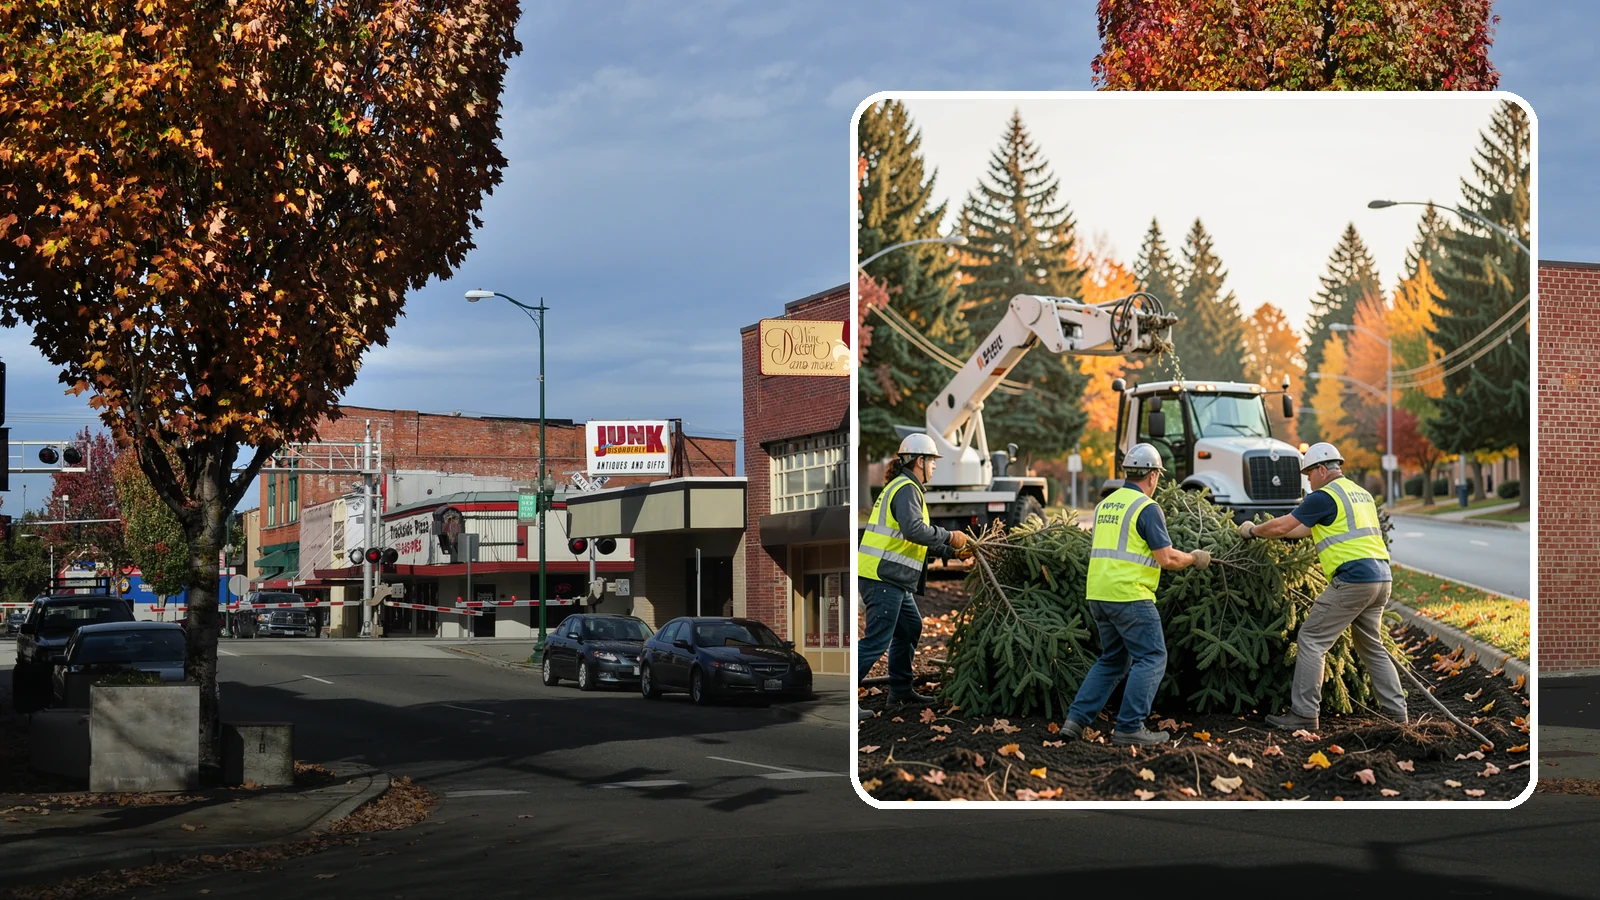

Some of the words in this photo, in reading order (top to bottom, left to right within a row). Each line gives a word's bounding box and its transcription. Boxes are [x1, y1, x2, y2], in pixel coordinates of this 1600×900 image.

[764, 327, 831, 365] Decor
[595, 425, 665, 457] JUNK
[607, 446, 646, 454] DISORDERLY
[597, 461, 628, 470] ANTIQUES
[631, 461, 644, 470] AND
[647, 460, 666, 470] GIFTS
[390, 523, 413, 540] Trackside
[415, 519, 429, 534] Pizza
